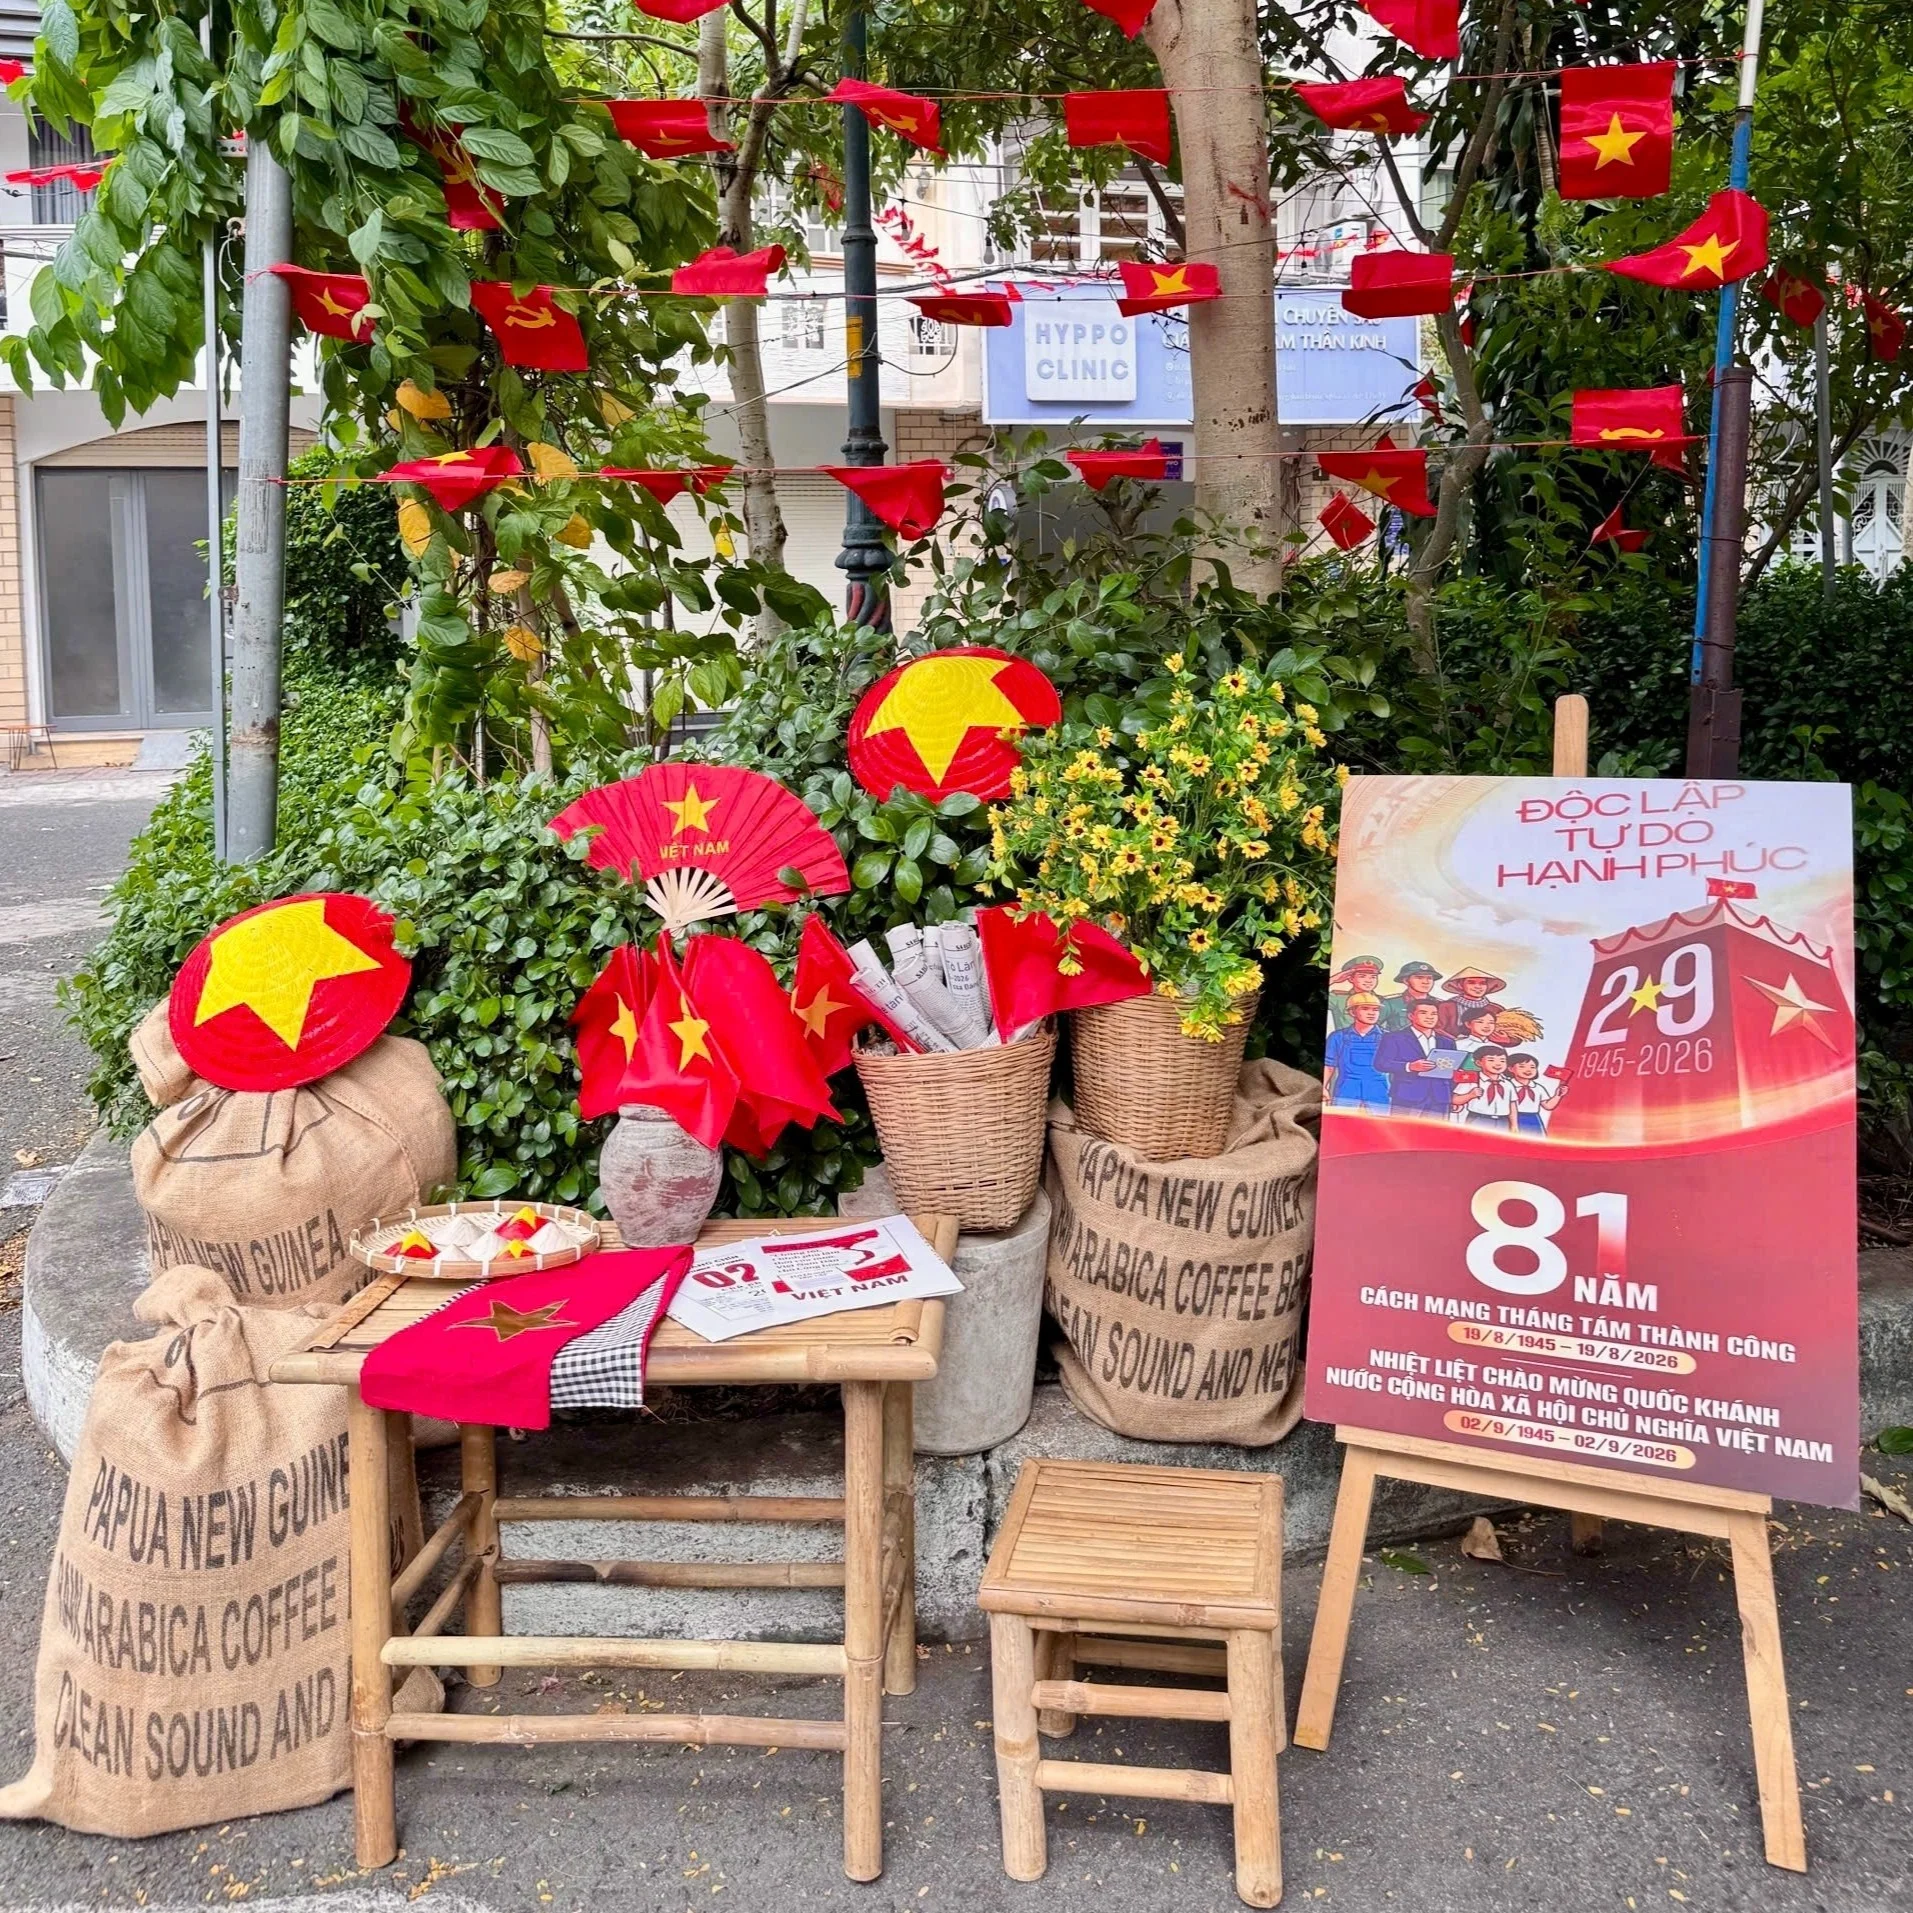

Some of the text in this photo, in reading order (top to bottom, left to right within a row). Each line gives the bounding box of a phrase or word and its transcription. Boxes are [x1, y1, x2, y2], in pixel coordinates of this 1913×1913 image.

[1036, 322, 1128, 345] HYPPO
[1283, 304, 1348, 326] CHUYÊN
[1350, 335, 1387, 351] KINH
[1036, 358, 1129, 380] CLINIC
[1515, 779, 1748, 825] ĐỘC LẬP
[694, 840, 729, 857] NAM
[1555, 819, 1715, 855] TỰ DO
[1497, 841, 1808, 889] HẠNH PHÚC
[1576, 1037, 1714, 1080] 1945-2026
[1156, 1177, 1223, 1234] NEW
[250, 1208, 346, 1296] GUINEA
[1465, 1179, 1629, 1296] 81
[692, 1263, 760, 1288] 02
[791, 1287, 843, 1301] VIỆT
[851, 1274, 909, 1294] NAM
[1067, 1221, 1168, 1311] ARABICA
[1174, 1259, 1274, 1321] COFFEE
[1574, 1273, 1659, 1312] NĂM
[1360, 1285, 1797, 1363] CÁCH MẠNG THÁNG TÁM THÀNH CÔNG
[1462, 1325, 1557, 1352] 19/8/1945
[1576, 1340, 1679, 1369] 19/8/2026
[1102, 1320, 1196, 1399] SOUND
[1195, 1346, 1254, 1401] AND
[1369, 1348, 1780, 1428] NHIỆT LIỆT CHÀO MỪNG QUỐC KHÁNH
[1325, 1366, 1833, 1463] NƯỚC CỘNG HÒA XÃ HỘI CHỦ NGHĨA VIỆT NAM
[1460, 1414, 1555, 1444] 02/9/1945
[1574, 1431, 1677, 1463] 02/9/2026
[84, 1455, 170, 1569] PAPUA
[181, 1480, 257, 1570] NEW
[268, 1431, 350, 1548] GUINE
[84, 1582, 211, 1677] ARABICA
[220, 1556, 338, 1671] COFFEE
[53, 1667, 335, 1782] CLEAN SOUND AND
